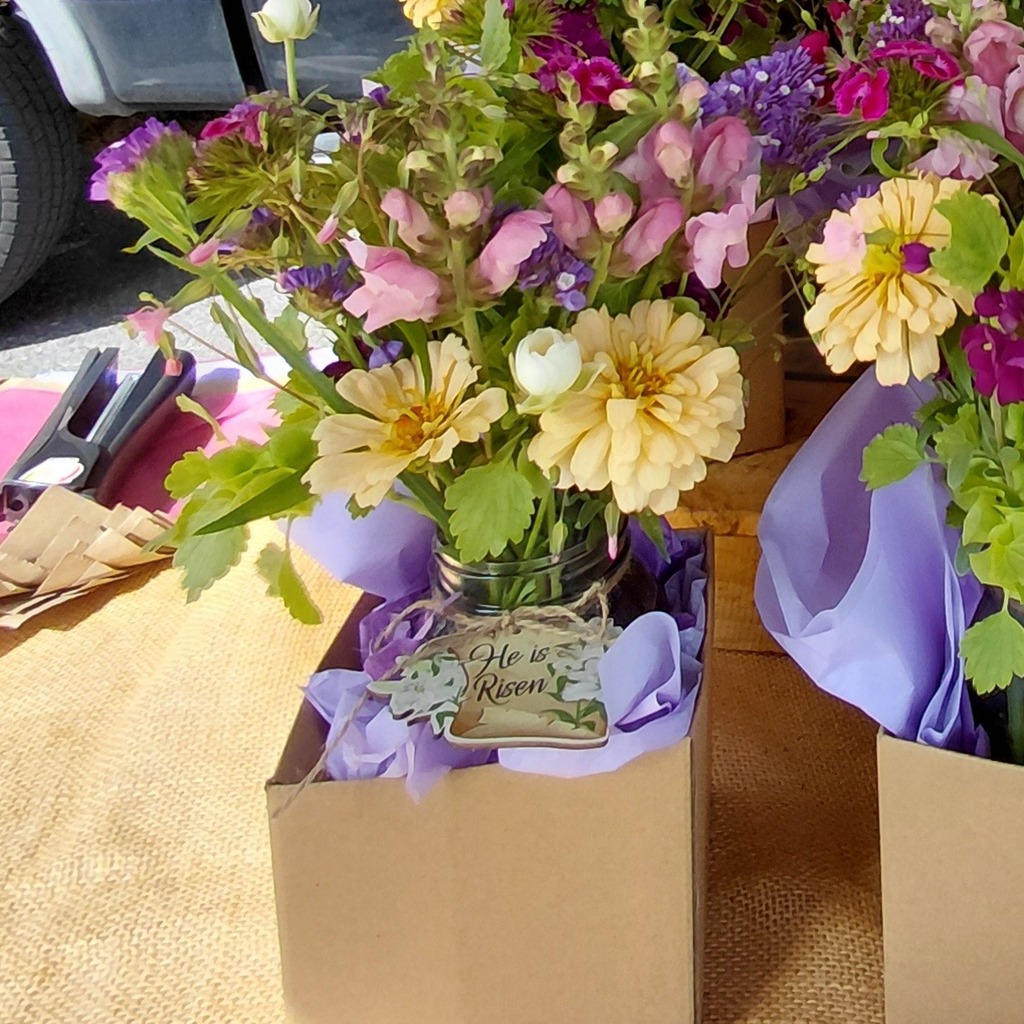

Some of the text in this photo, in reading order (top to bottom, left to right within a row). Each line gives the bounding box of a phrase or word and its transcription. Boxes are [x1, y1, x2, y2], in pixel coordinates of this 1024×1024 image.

[469, 642, 550, 679] He is
[473, 672, 549, 705] Risen
